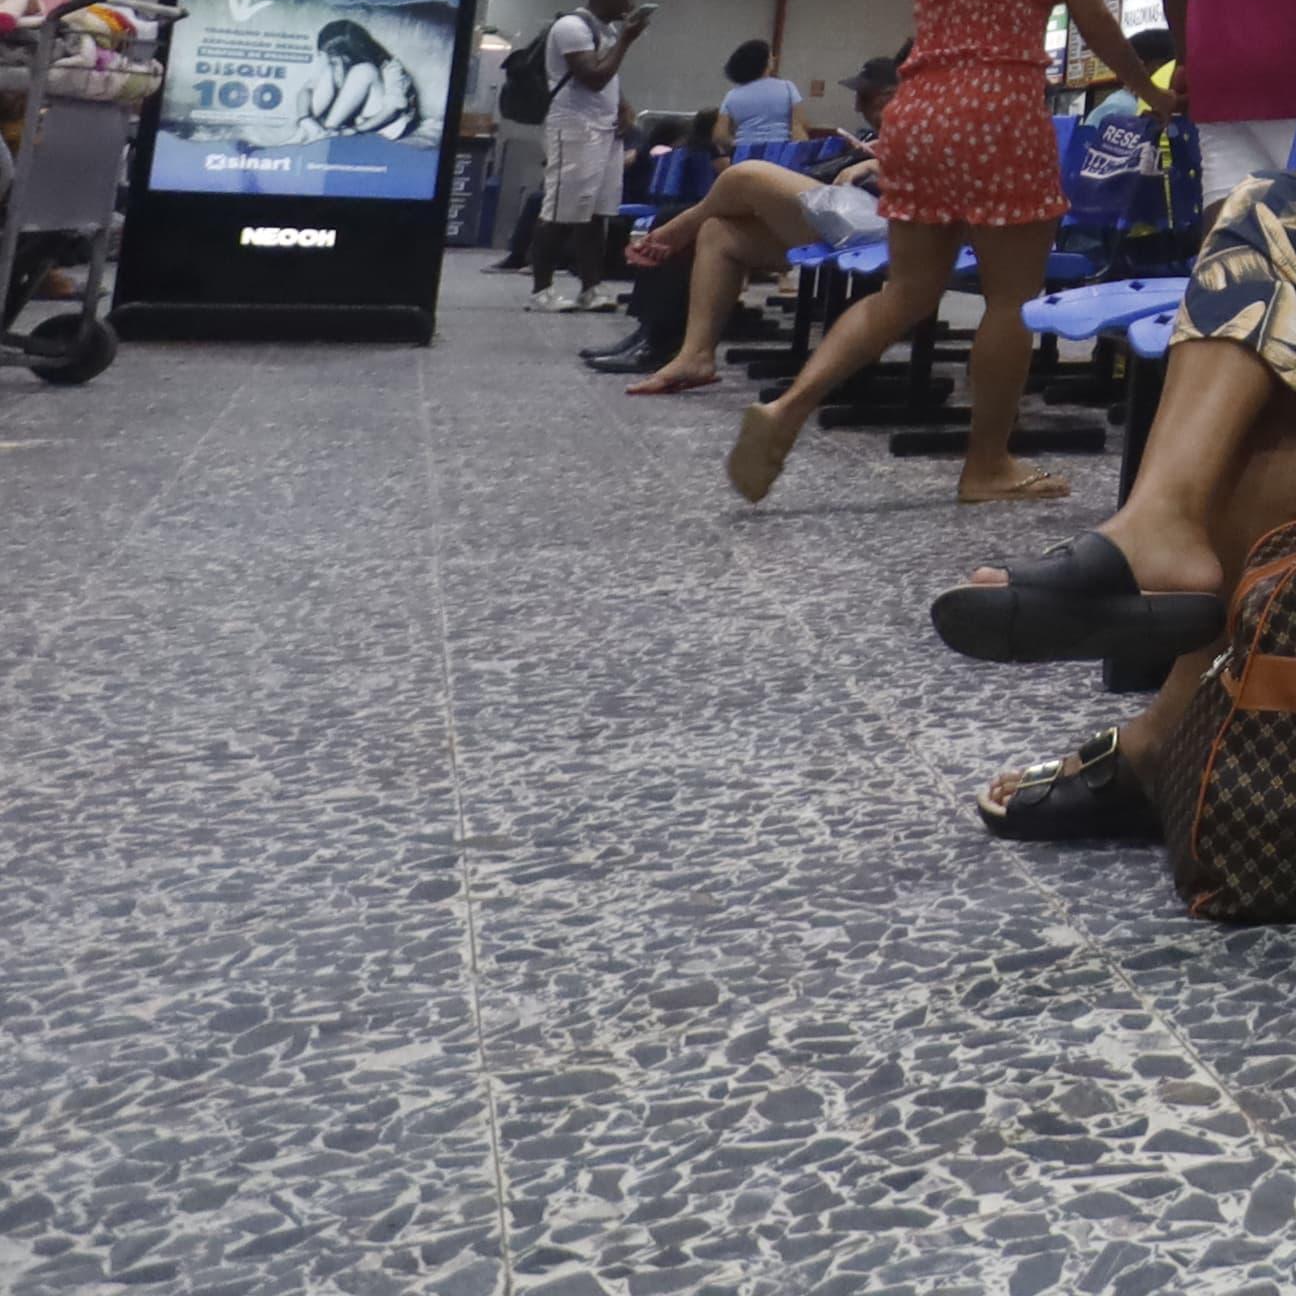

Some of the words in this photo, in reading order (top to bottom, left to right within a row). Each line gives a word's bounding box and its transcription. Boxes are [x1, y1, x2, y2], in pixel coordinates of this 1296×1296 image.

[191, 79, 283, 110] 100
[224, 154, 291, 172] sinart
[240, 227, 336, 247] NEOOH
